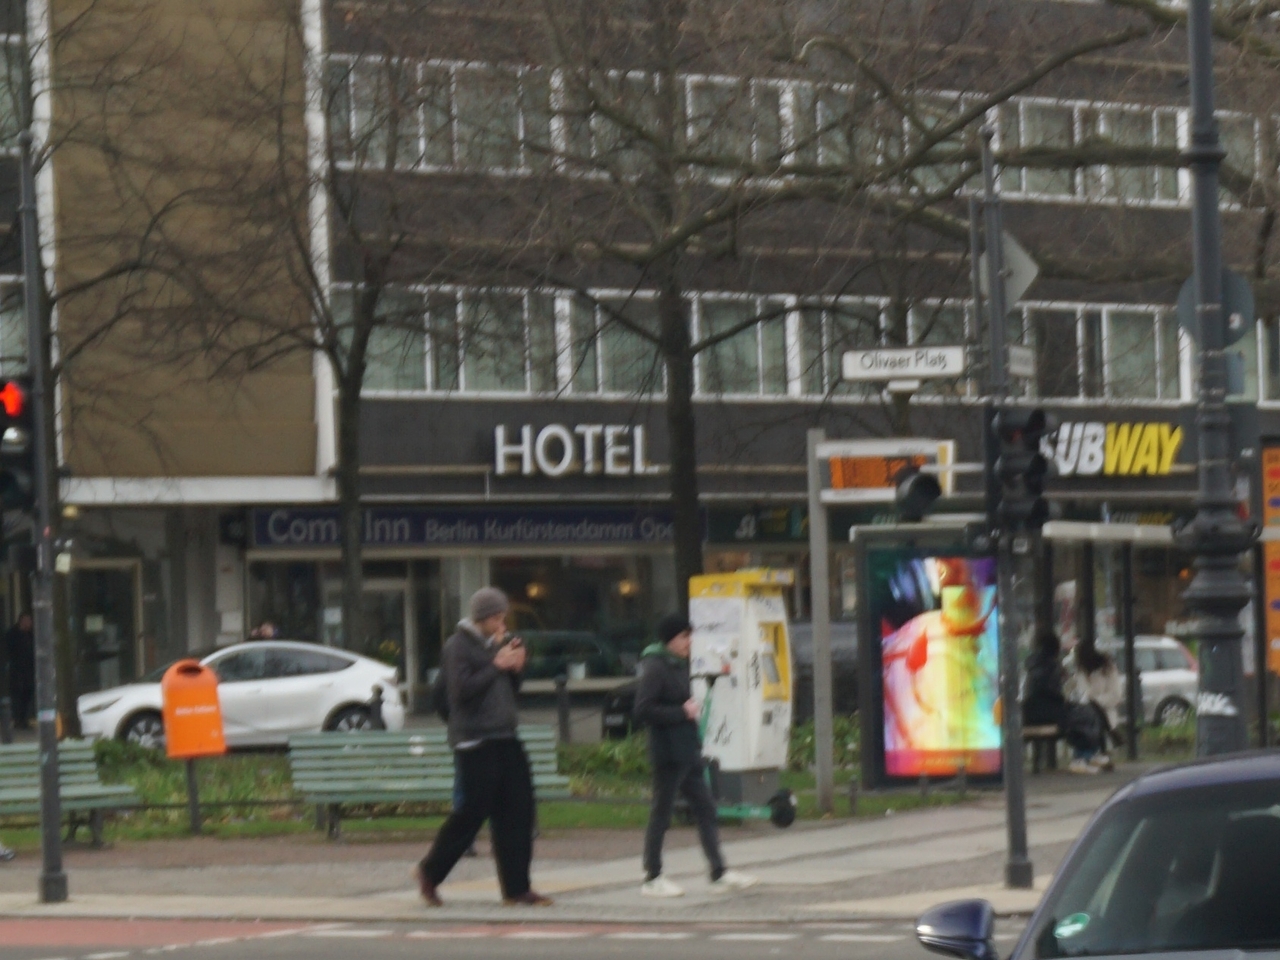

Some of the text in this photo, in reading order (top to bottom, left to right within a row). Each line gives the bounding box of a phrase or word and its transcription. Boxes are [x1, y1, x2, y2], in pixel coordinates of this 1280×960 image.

[860, 352, 911, 370] Olivaer
[495, 424, 659, 476] HOTEL
[268, 509, 342, 543] Com
[365, 509, 410, 541] Inn
[425, 518, 478, 541] Berlin
[484, 517, 633, 541] Kurfürstendamm
